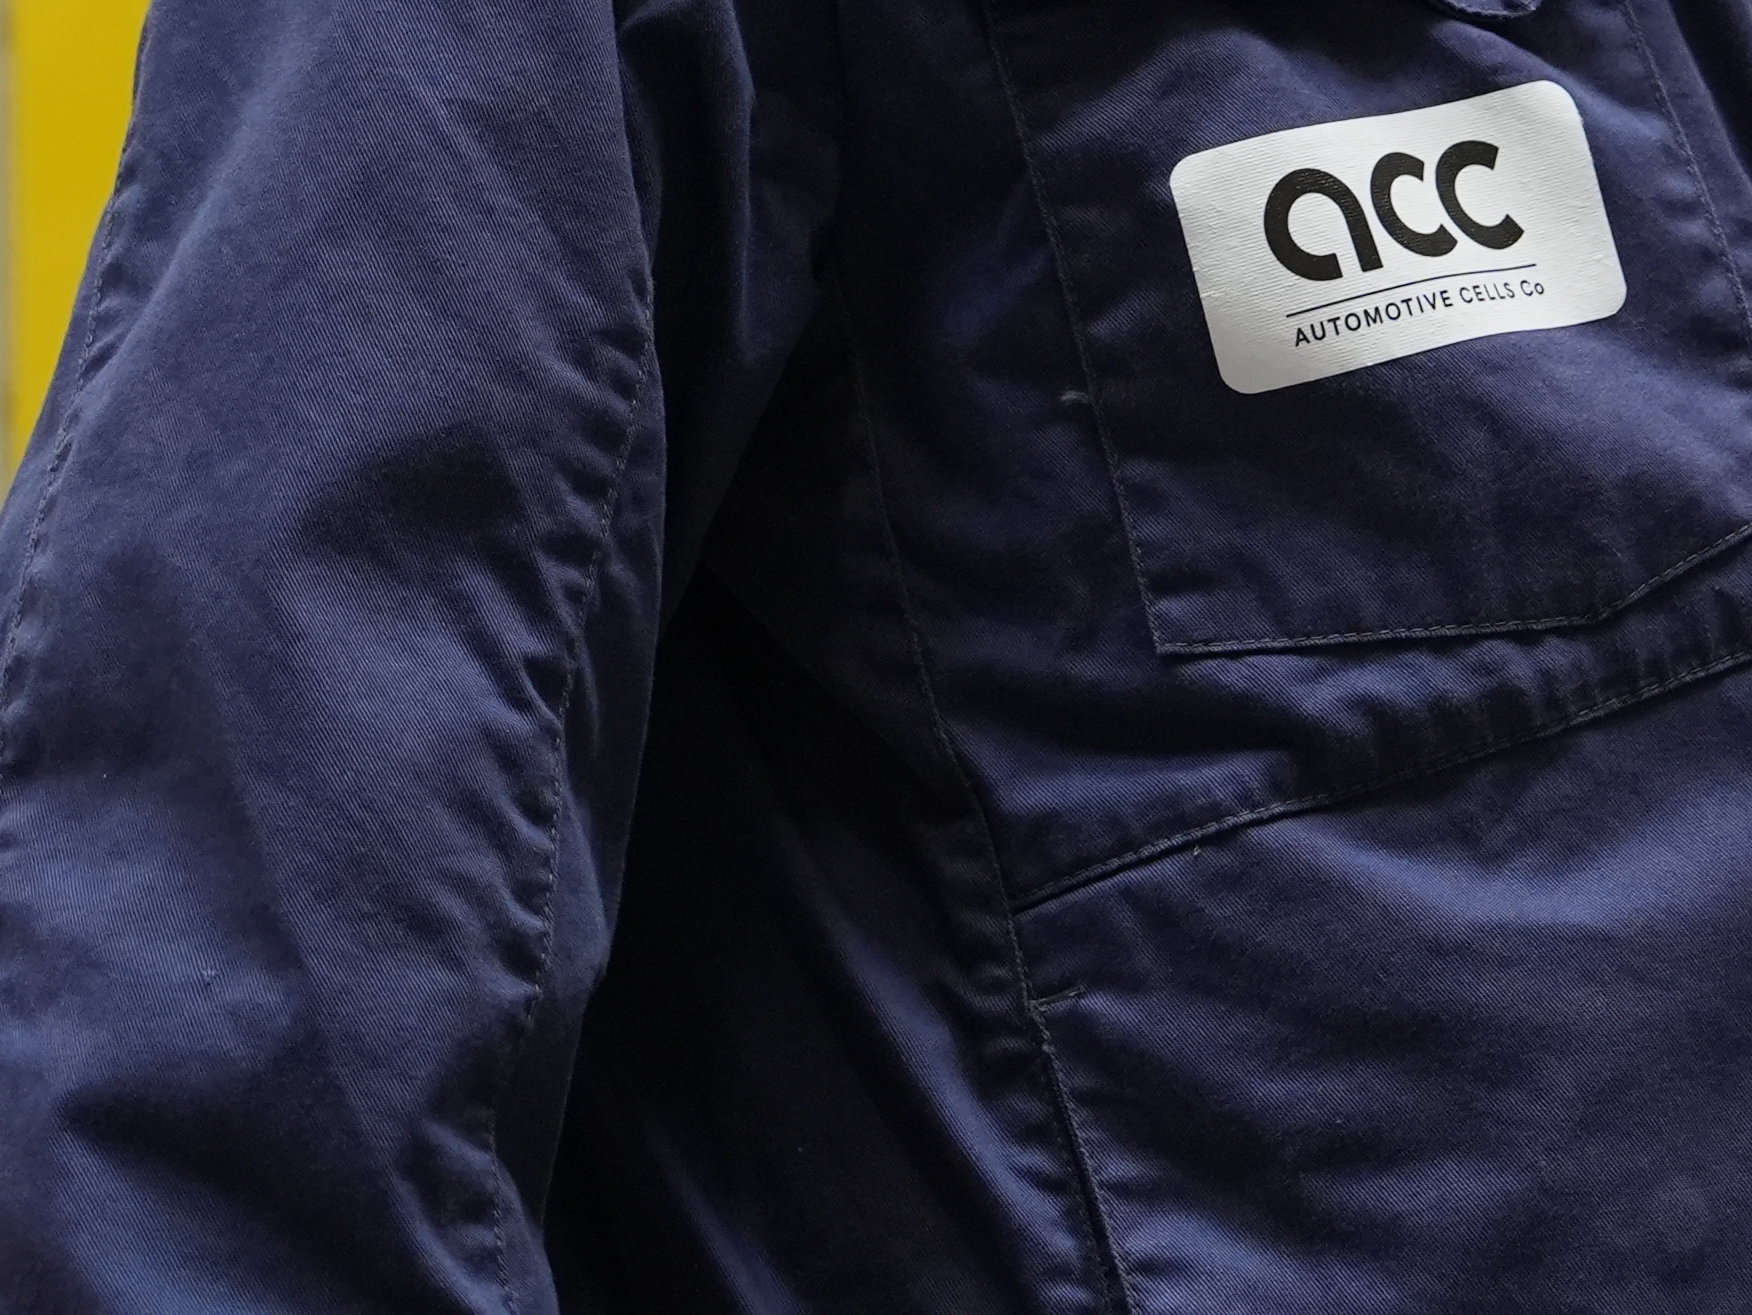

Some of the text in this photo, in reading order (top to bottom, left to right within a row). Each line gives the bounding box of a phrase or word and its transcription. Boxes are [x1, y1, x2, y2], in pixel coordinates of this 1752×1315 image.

[1264, 140, 1525, 281] acc
[1295, 279, 1545, 347] AUTOMOTIVE CELLS Co
